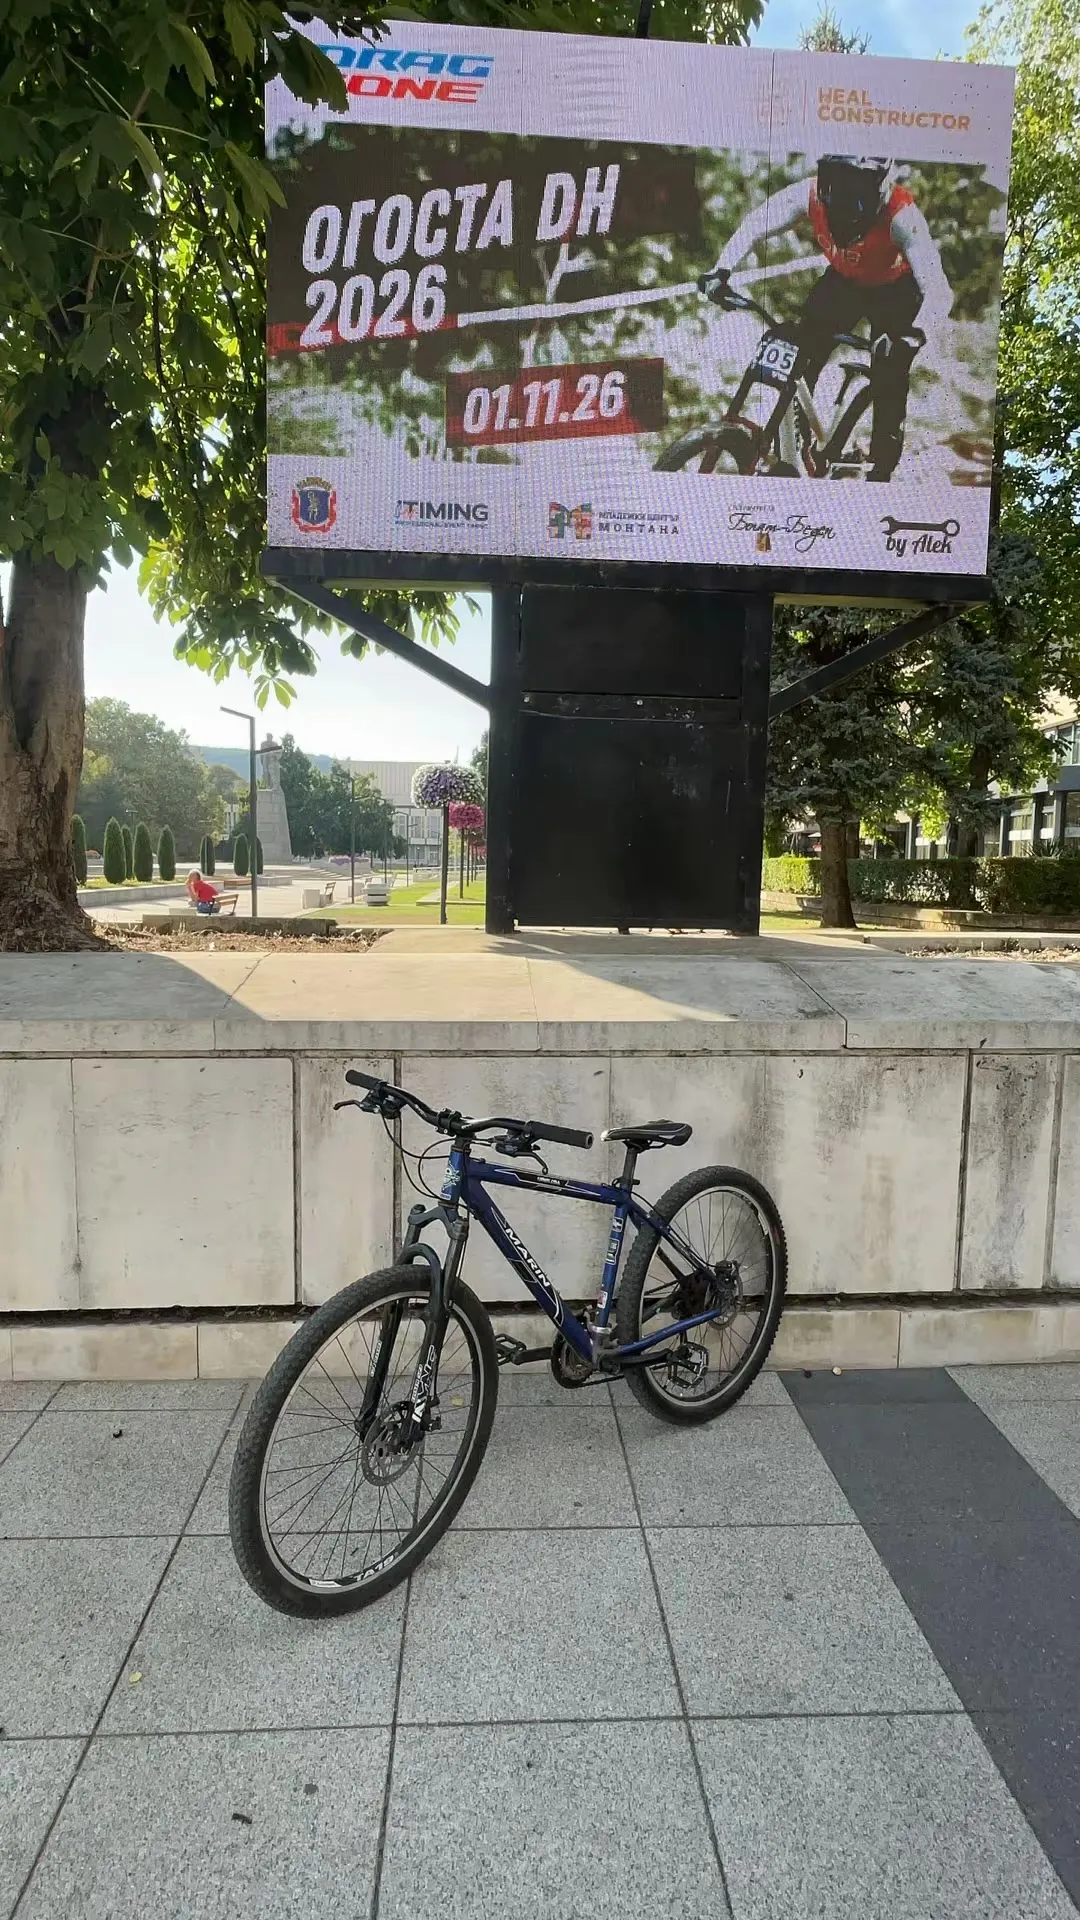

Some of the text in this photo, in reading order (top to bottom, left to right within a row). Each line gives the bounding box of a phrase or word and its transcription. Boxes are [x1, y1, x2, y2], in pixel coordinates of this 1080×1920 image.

[341, 74, 485, 104] ONE
[817, 87, 873, 106] HEAL
[816, 104, 971, 131] CONSTRUCTOR
[302, 163, 621, 274] ОГОСТА DH
[299, 263, 448, 350] 2026
[463, 370, 627, 435] 01.11.26
[598, 522, 680, 535] МОНТАНА
[886, 533, 953, 557] by Alek
[505, 1228, 551, 1288] MARIN
